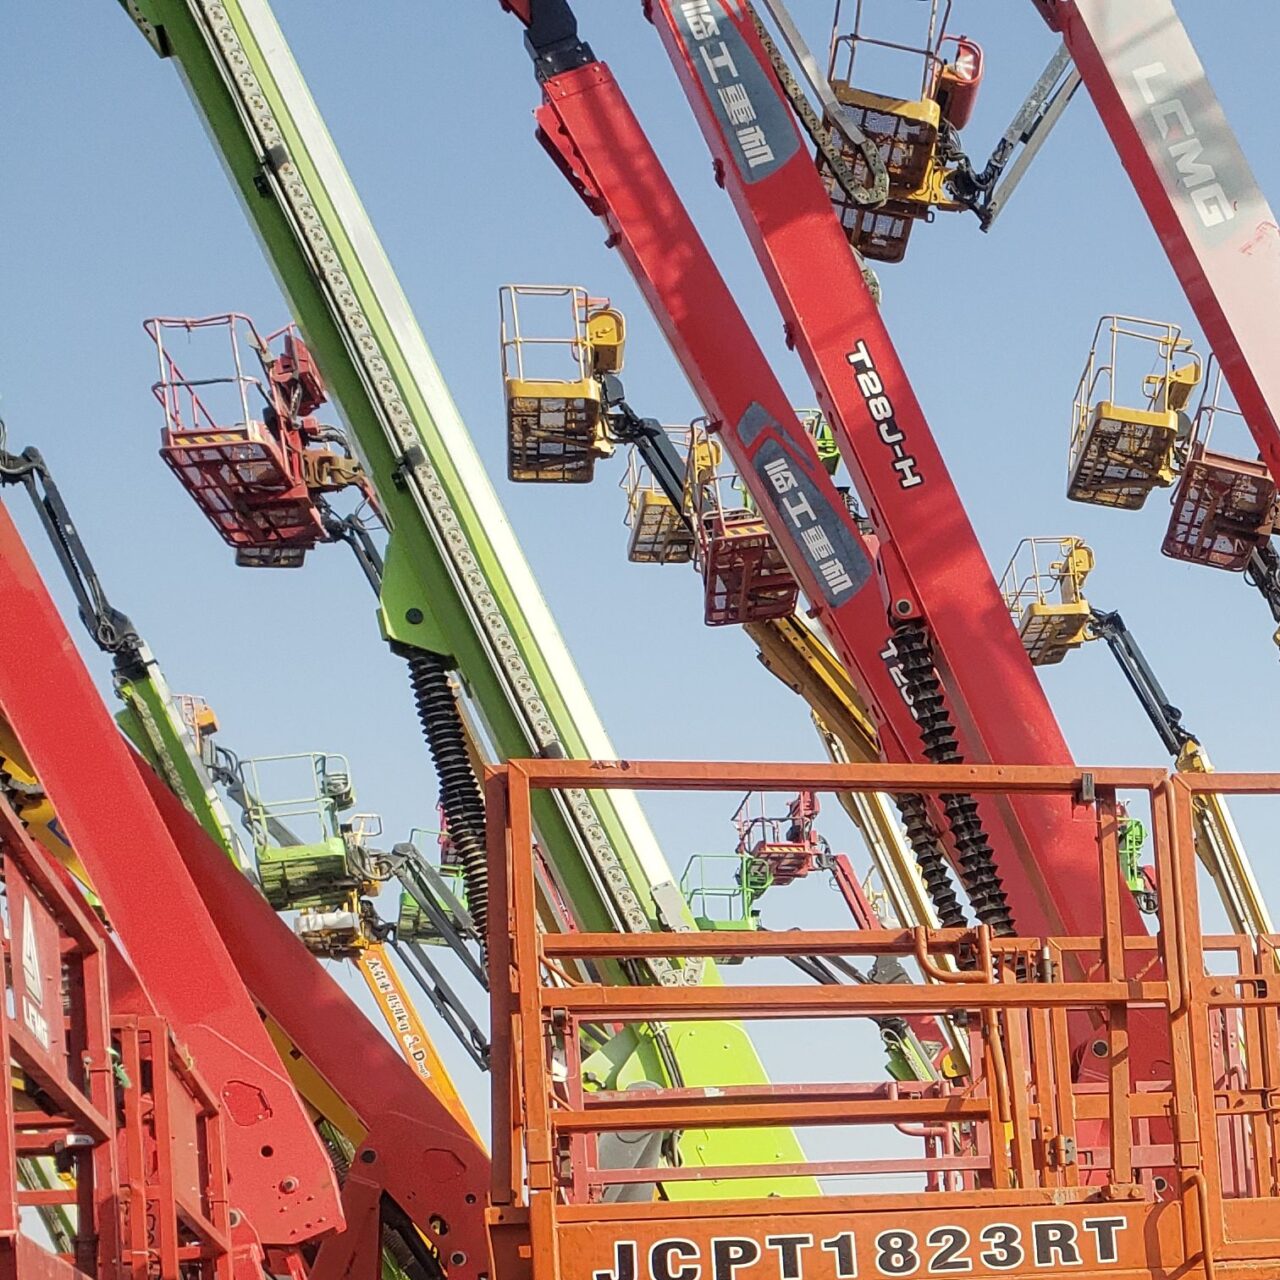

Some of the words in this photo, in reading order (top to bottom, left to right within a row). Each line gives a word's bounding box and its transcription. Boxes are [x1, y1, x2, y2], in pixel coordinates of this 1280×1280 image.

[680, 0, 775, 168] 临工重机
[847, 339, 923, 489] T28J-H
[764, 457, 854, 596] 临工重机
